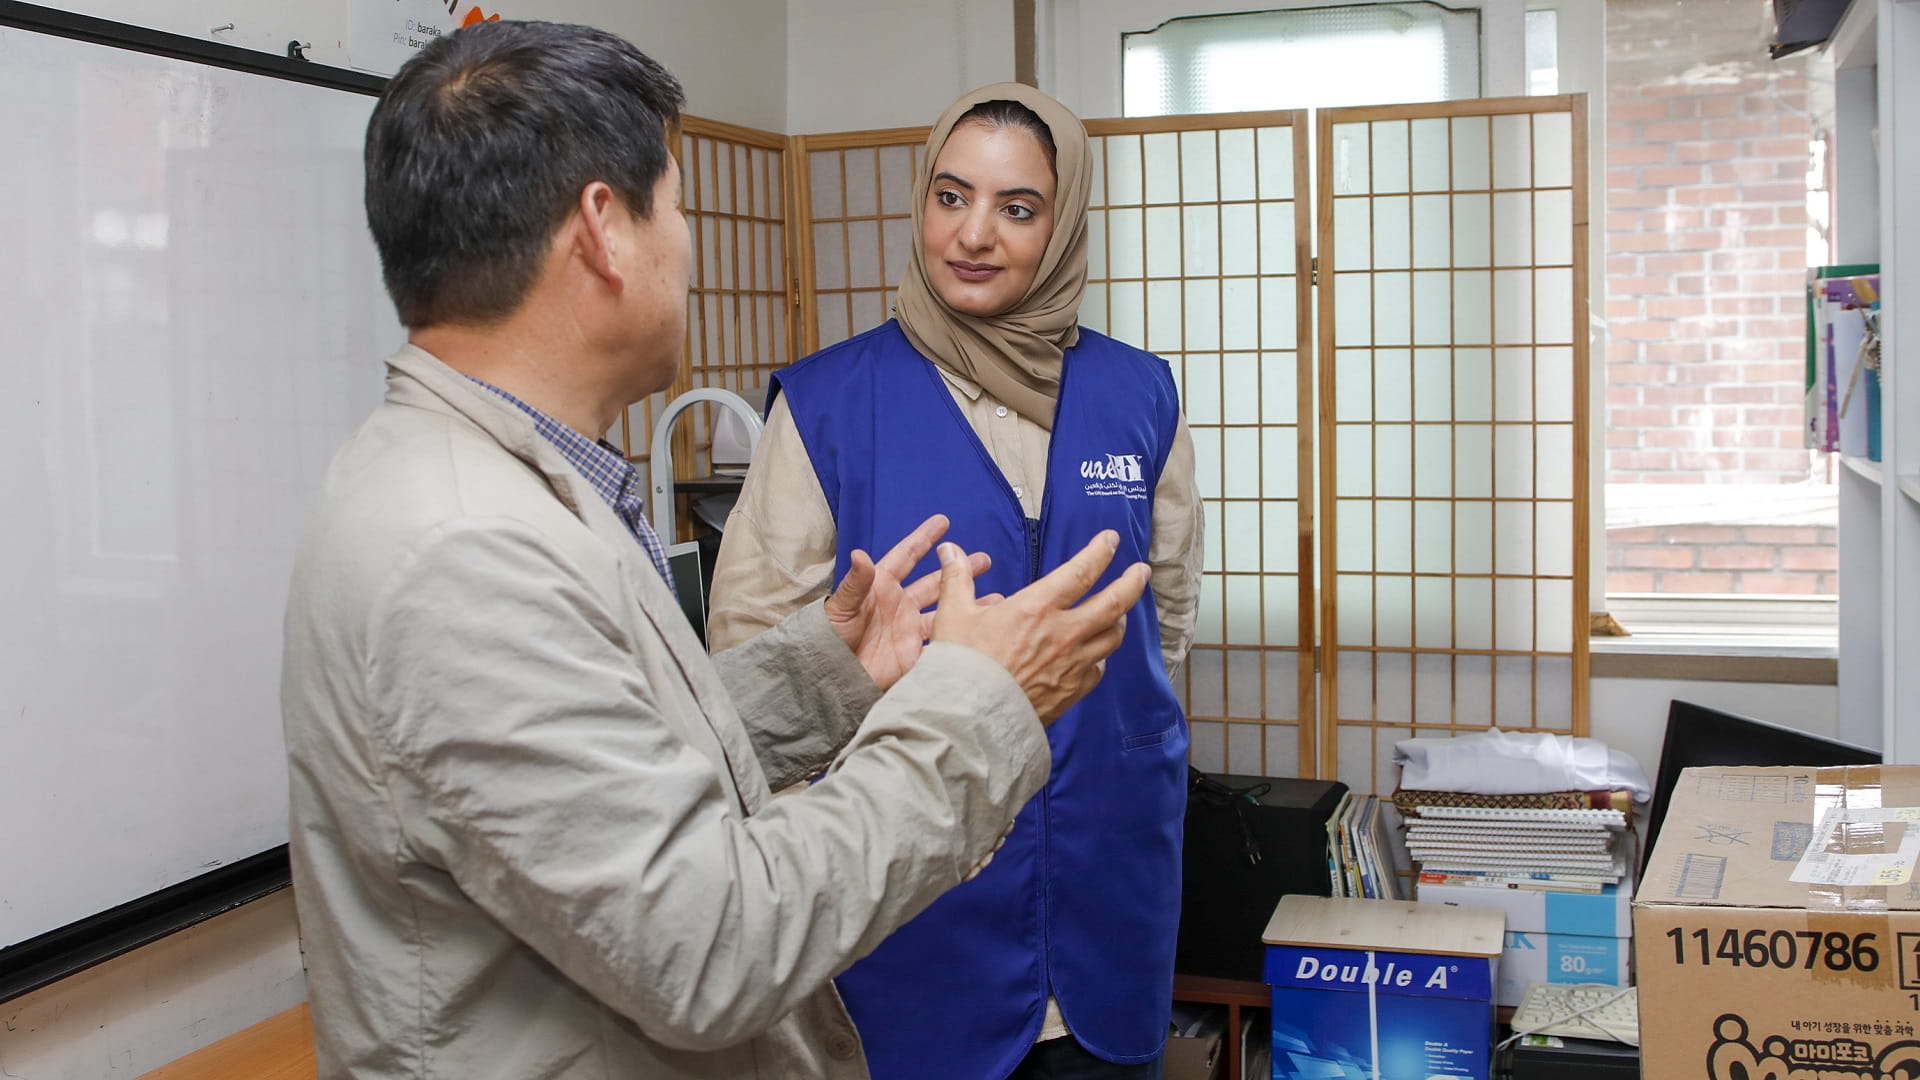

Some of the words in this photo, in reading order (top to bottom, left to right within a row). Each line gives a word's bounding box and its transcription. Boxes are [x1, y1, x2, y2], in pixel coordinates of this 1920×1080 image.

[405, 19, 416, 32] ID:
[417, 22, 441, 37] baraka
[408, 36, 427, 50] bara
[1666, 927, 1880, 972] 11460786
[1295, 956, 1413, 987] Double
[1560, 955, 1586, 974] 80
[1791, 1020, 1800, 1031] 내
[1803, 1021, 1821, 1032] 아기
[1824, 1022, 1850, 1034] 성장을
[1853, 1023, 1872, 1035] 위한
[1874, 1023, 1893, 1036] 맞춤
[1895, 1024, 1914, 1037] 과학
[1794, 1042, 1870, 1062] 마미포코
